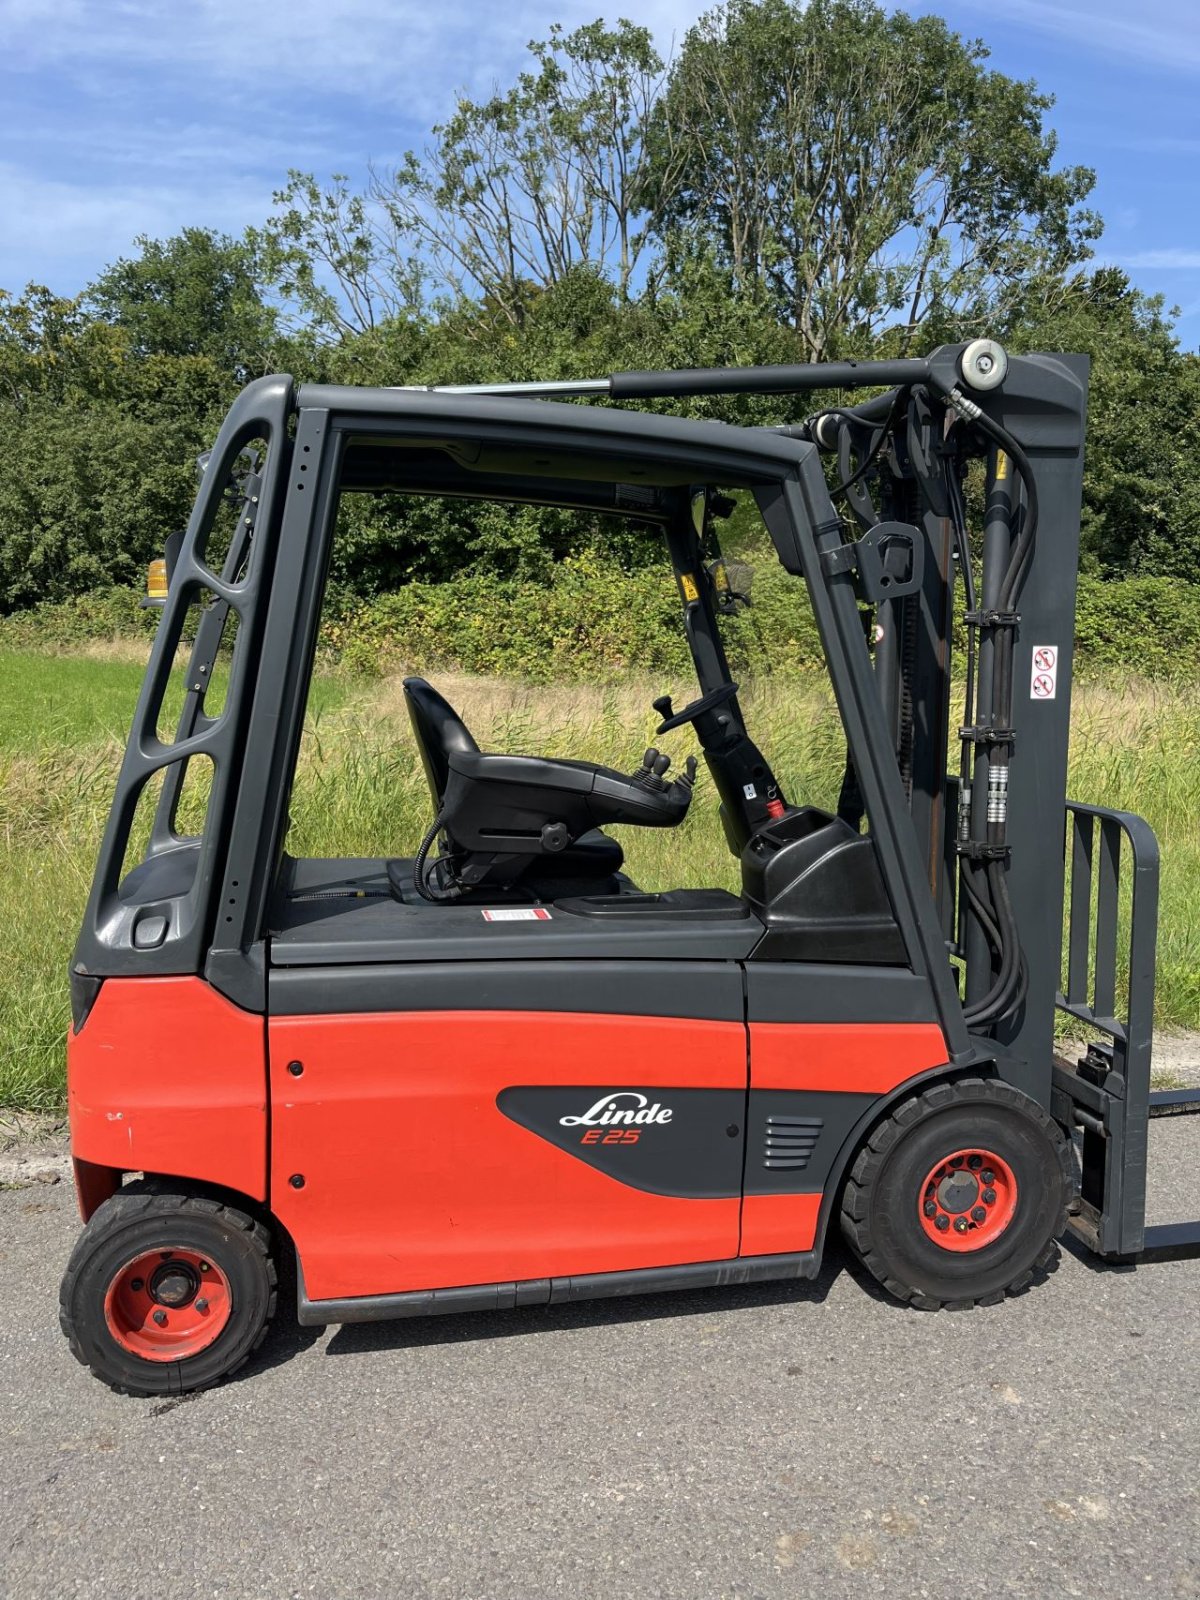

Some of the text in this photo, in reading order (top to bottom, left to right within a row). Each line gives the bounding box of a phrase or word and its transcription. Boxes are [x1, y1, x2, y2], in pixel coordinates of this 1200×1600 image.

[559, 1092, 673, 1126] Linde
[581, 1129, 641, 1145] E 25
